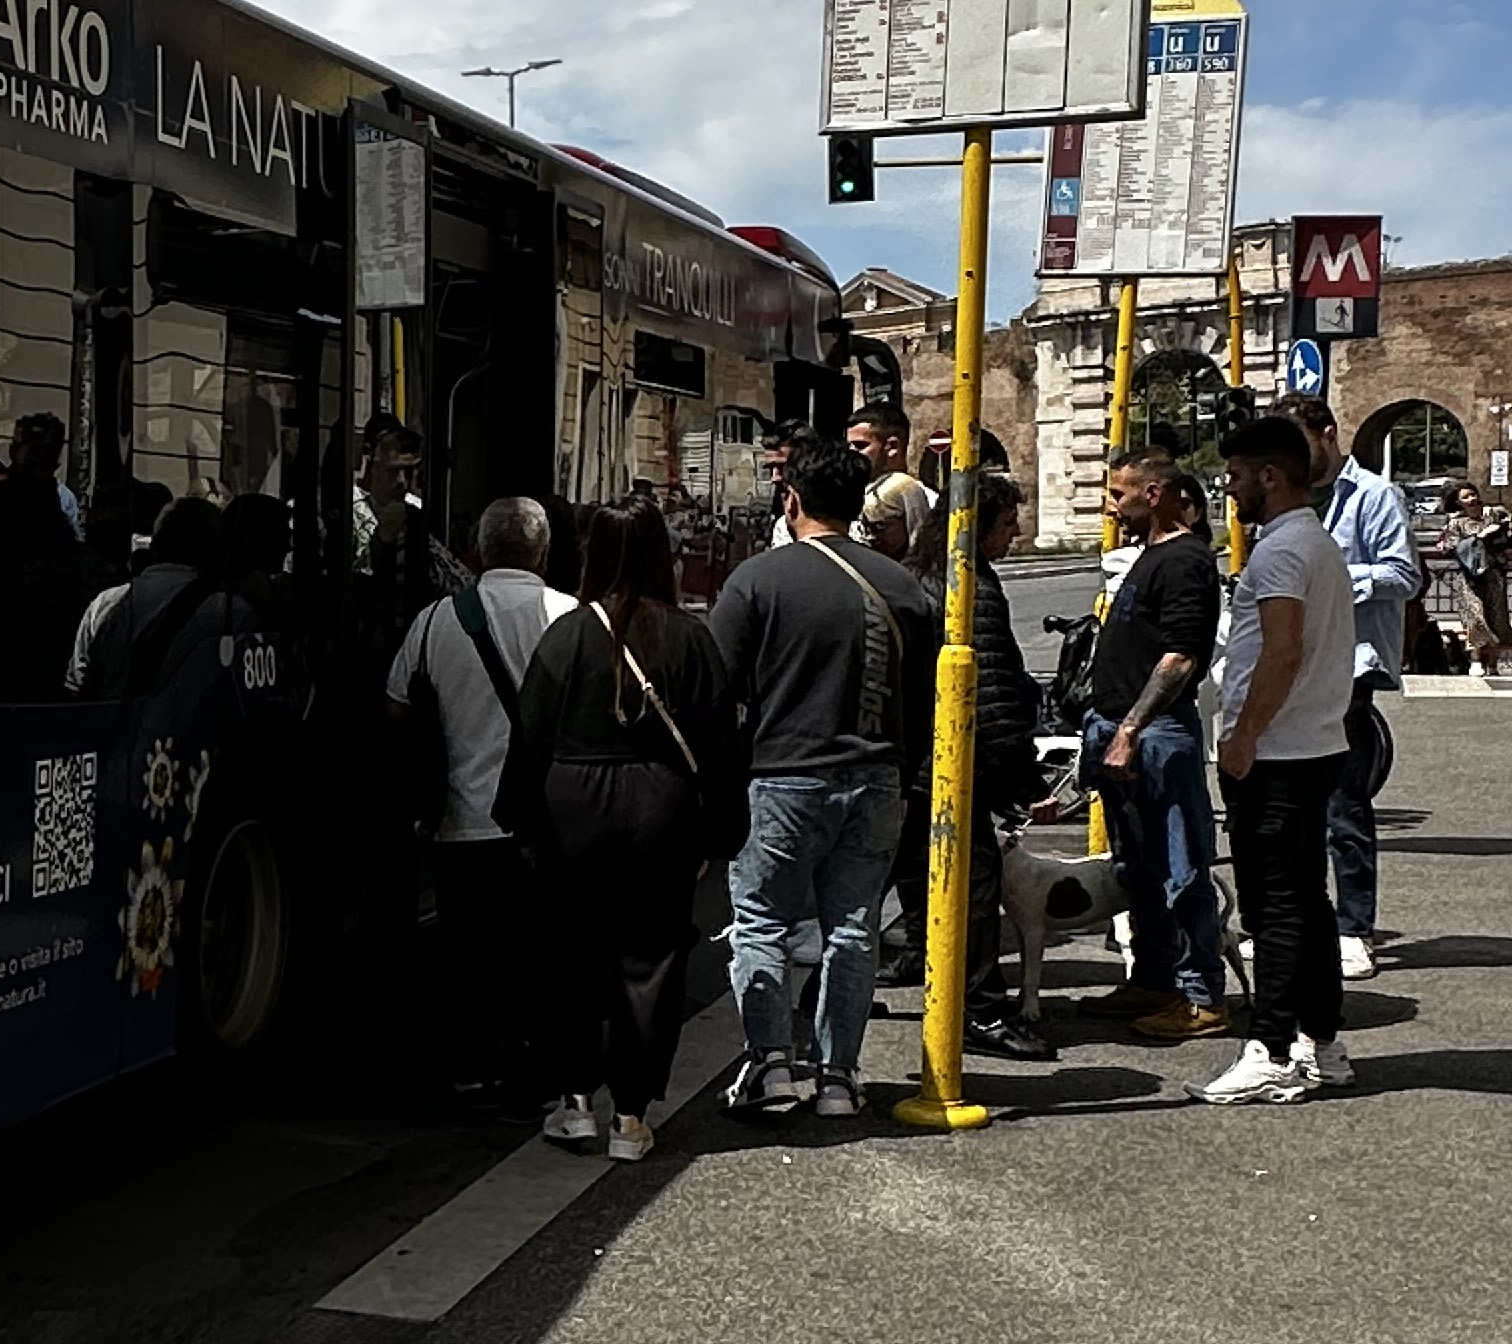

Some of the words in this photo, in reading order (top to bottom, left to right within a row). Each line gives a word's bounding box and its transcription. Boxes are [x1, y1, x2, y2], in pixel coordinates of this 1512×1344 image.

[156, 45, 216, 158] LA
[1298, 234, 1372, 282] M
[244, 645, 276, 690] 800
